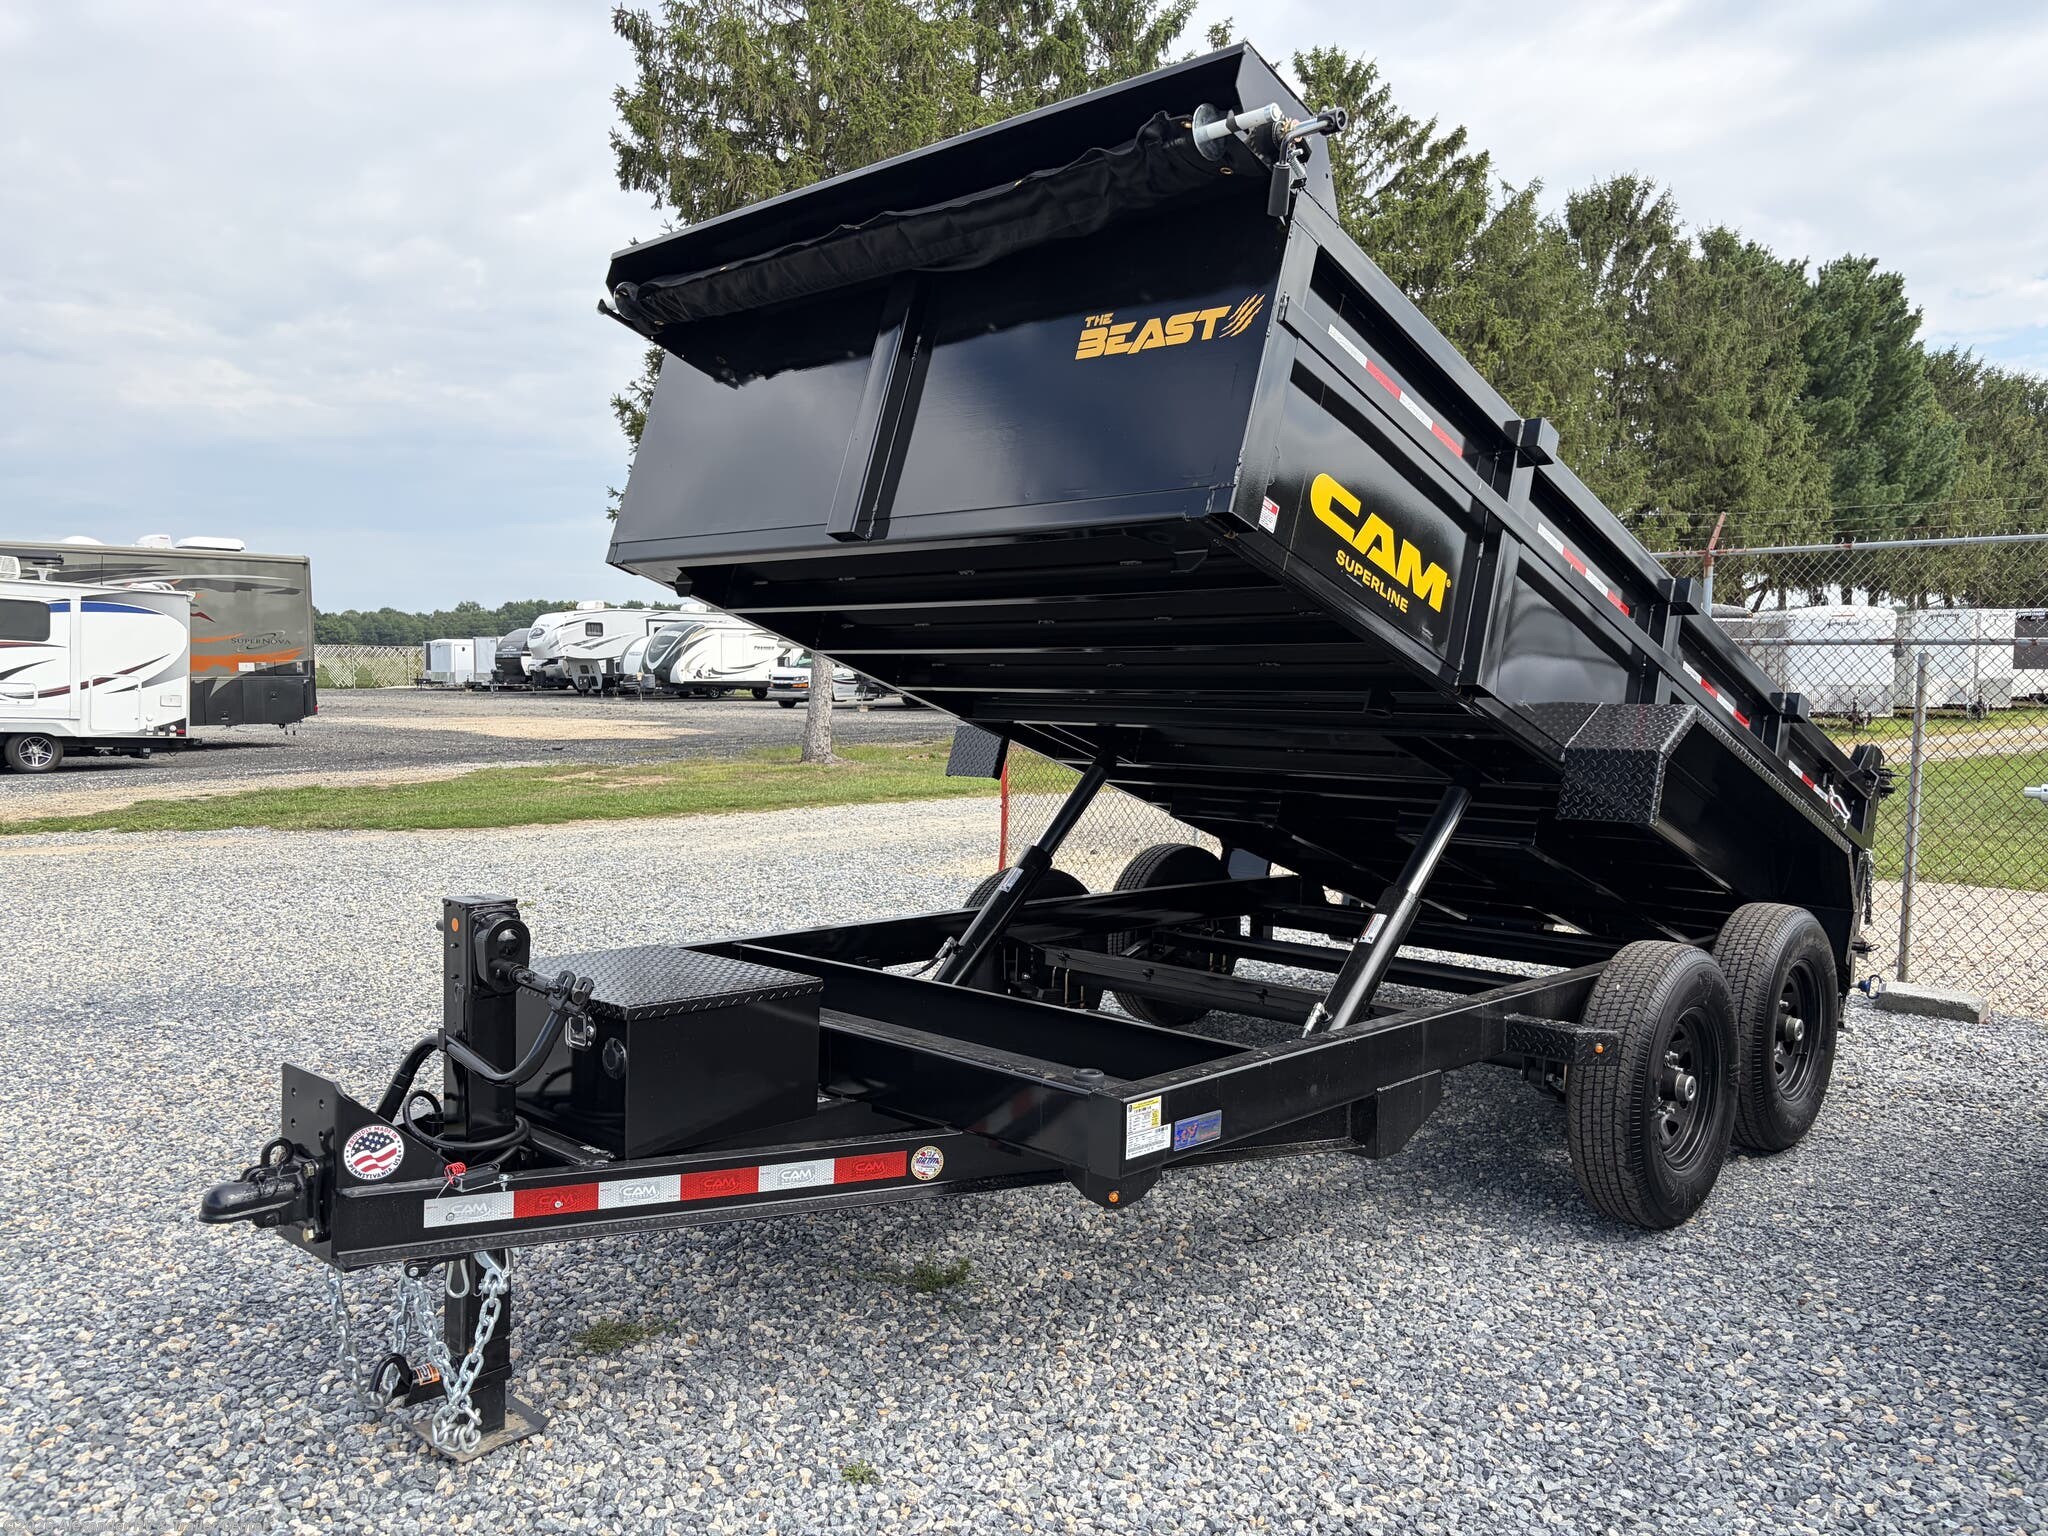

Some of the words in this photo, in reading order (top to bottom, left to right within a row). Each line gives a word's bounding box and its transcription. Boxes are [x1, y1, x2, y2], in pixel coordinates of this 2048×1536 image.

[1085, 312, 1114, 328] THE
[1074, 305, 1232, 360] BEAST
[1310, 472, 1448, 613] CAM
[1335, 549, 1410, 613] SUPERLINE
[347, 1127, 372, 1148] PROUDLY
[373, 1126, 392, 1135] MADE
[390, 1132, 398, 1140] IN
[348, 1163, 393, 1179] PENNSYLVANIA
[392, 1154, 403, 1166] USA
[780, 1169, 812, 1179] CAM
[855, 1161, 885, 1171] CAM
[622, 1185, 657, 1196] CAM
[703, 1177, 736, 1188] CAM
[452, 1202, 489, 1214] CAM
